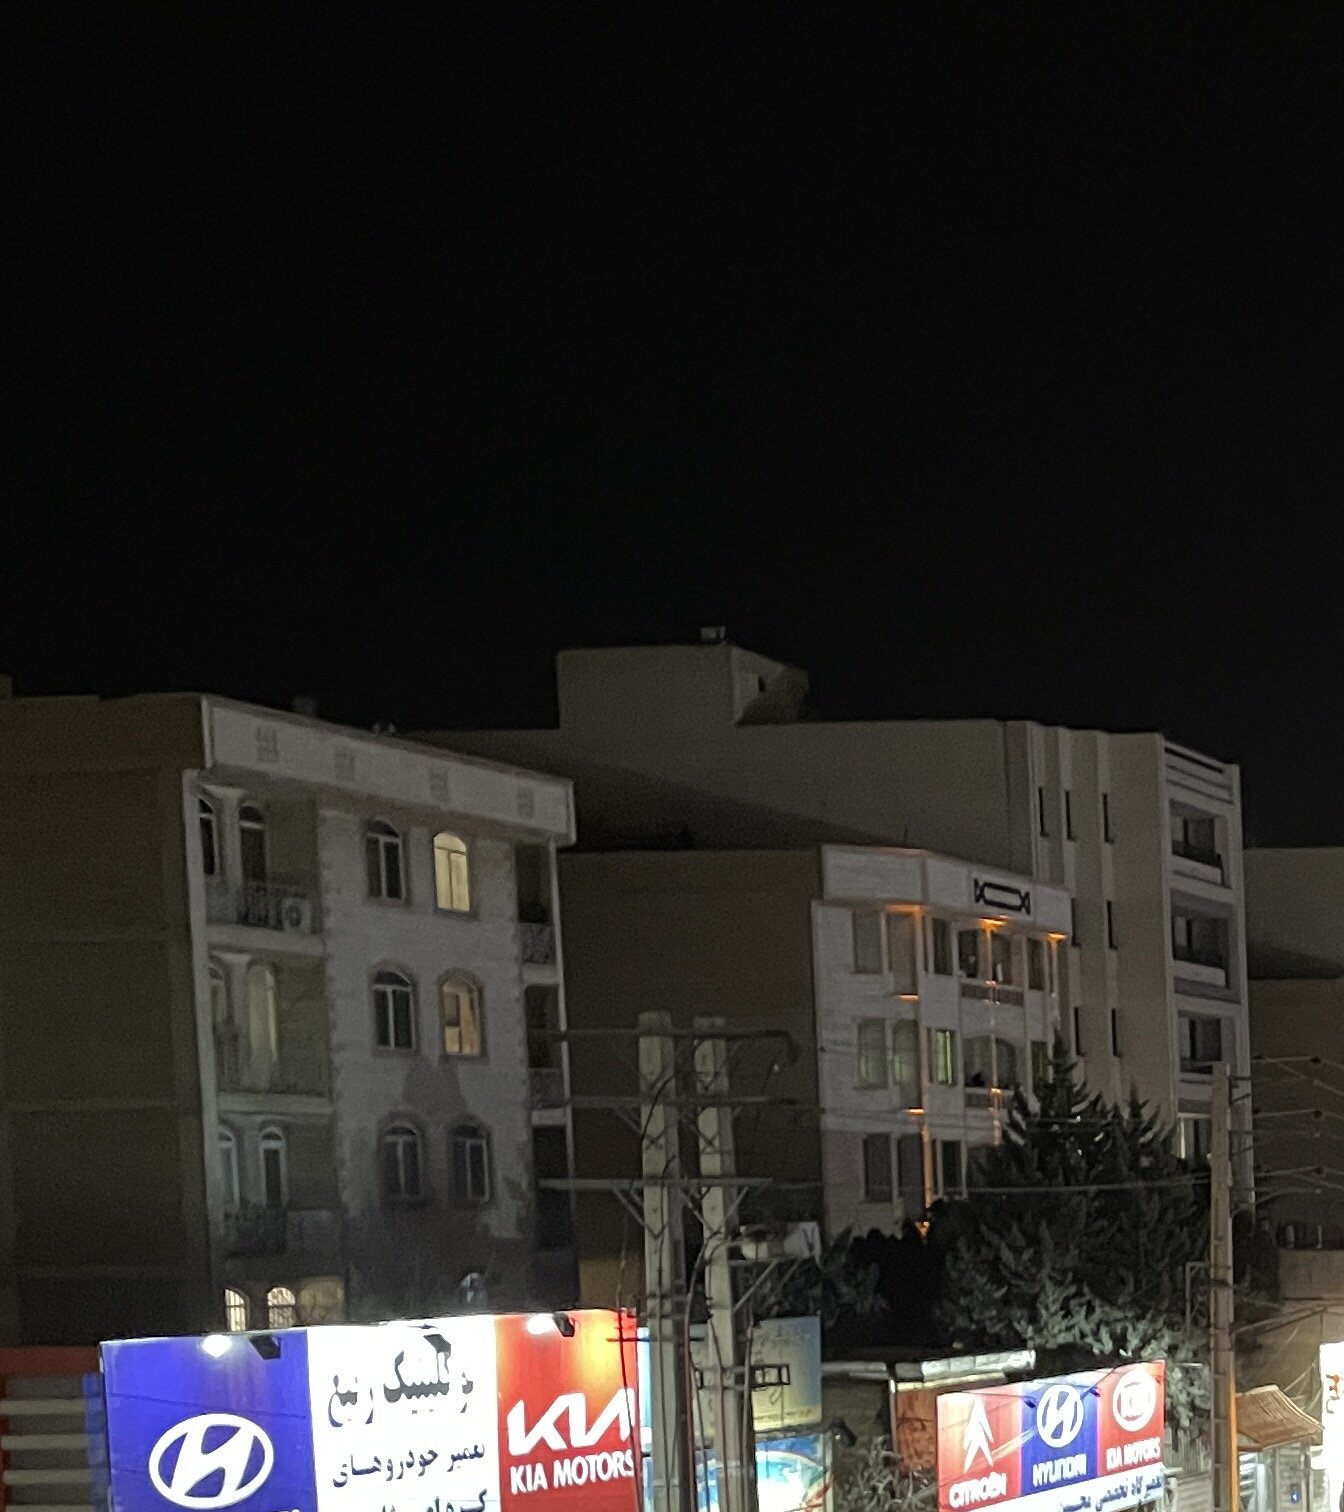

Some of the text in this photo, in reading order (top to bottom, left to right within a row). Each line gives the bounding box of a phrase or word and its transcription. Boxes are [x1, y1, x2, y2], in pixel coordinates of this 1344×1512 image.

[510, 1449, 635, 1495] KIA MOTORS
[1032, 1453, 1087, 1487] HYUNDAI
